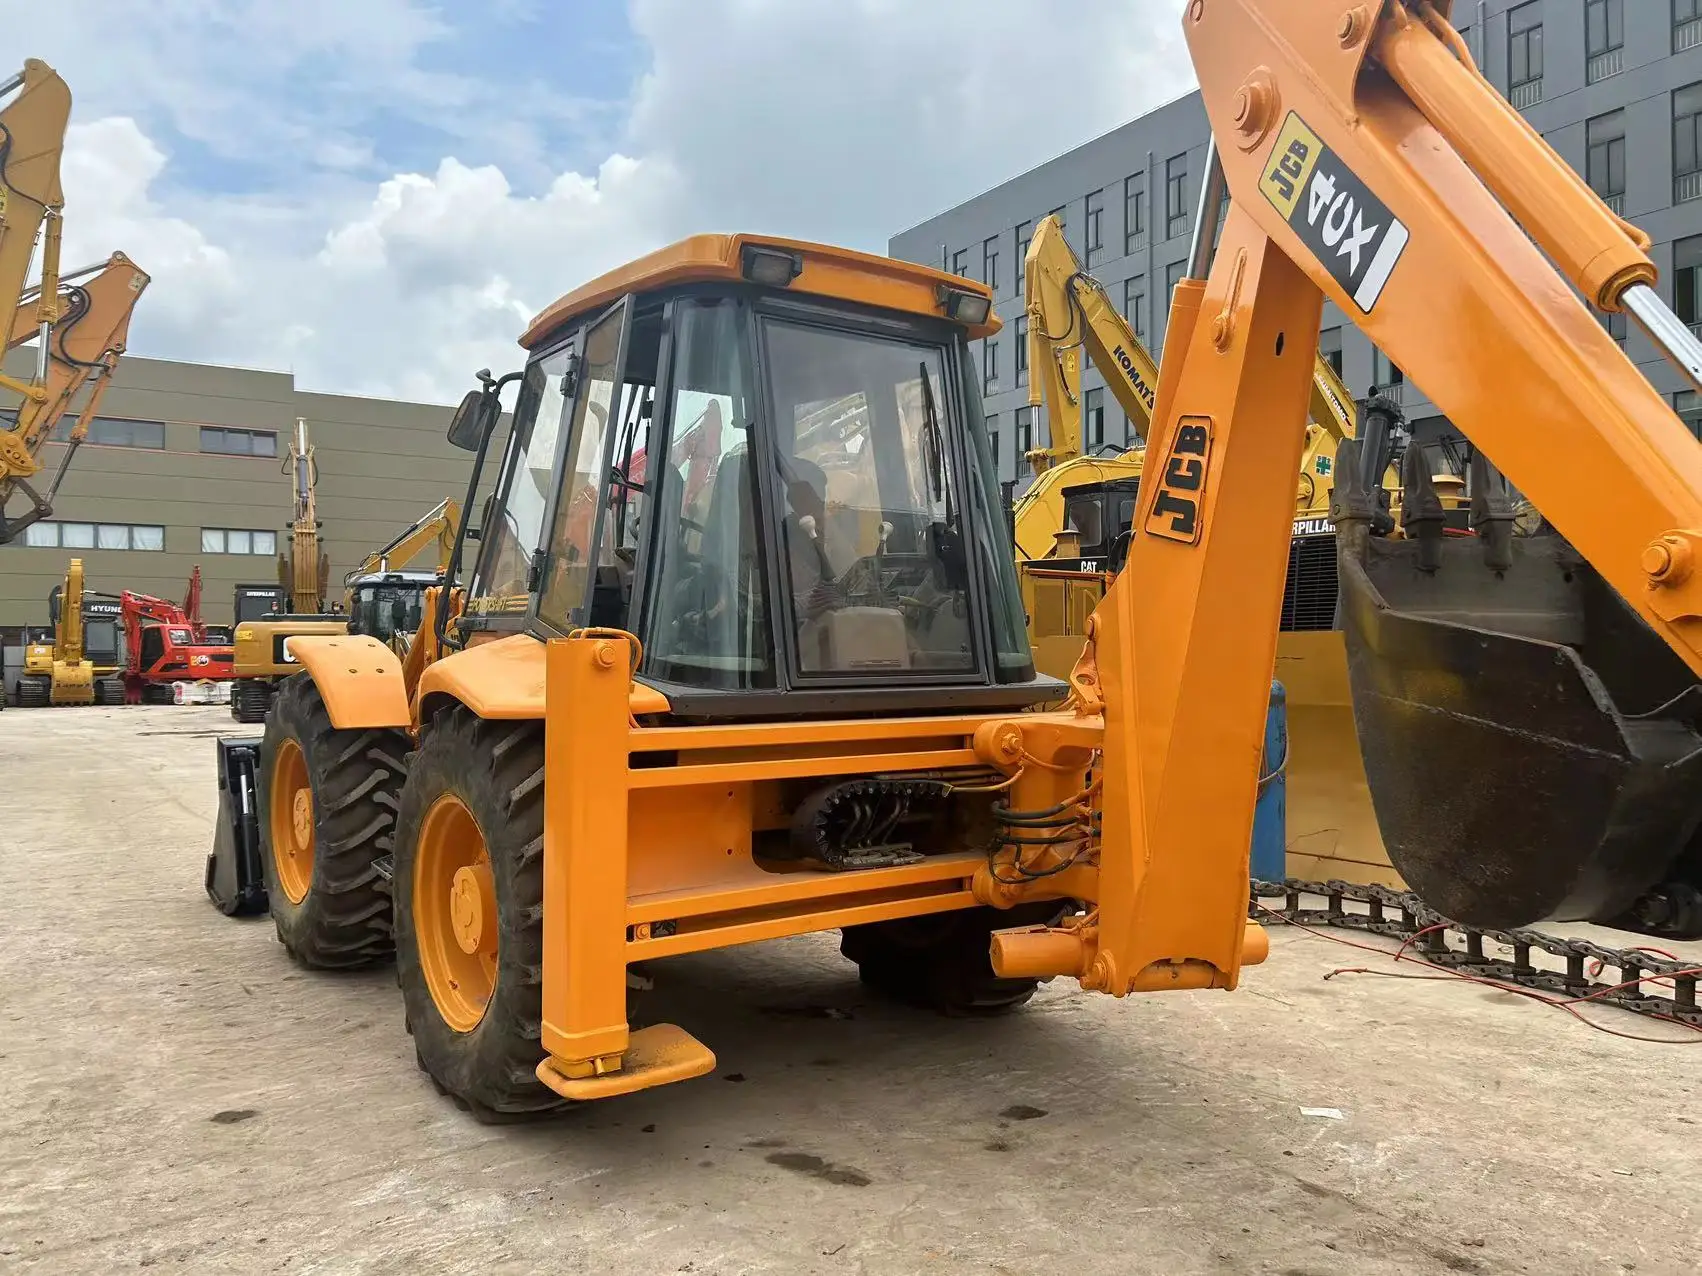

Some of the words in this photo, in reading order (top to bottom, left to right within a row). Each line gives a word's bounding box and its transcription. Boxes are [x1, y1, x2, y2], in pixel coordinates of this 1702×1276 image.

[1269, 139, 1309, 201] JCB
[1307, 169, 1380, 278] 4CX
[1152, 424, 1207, 534] JCB
[1080, 560, 1098, 573] CAT
